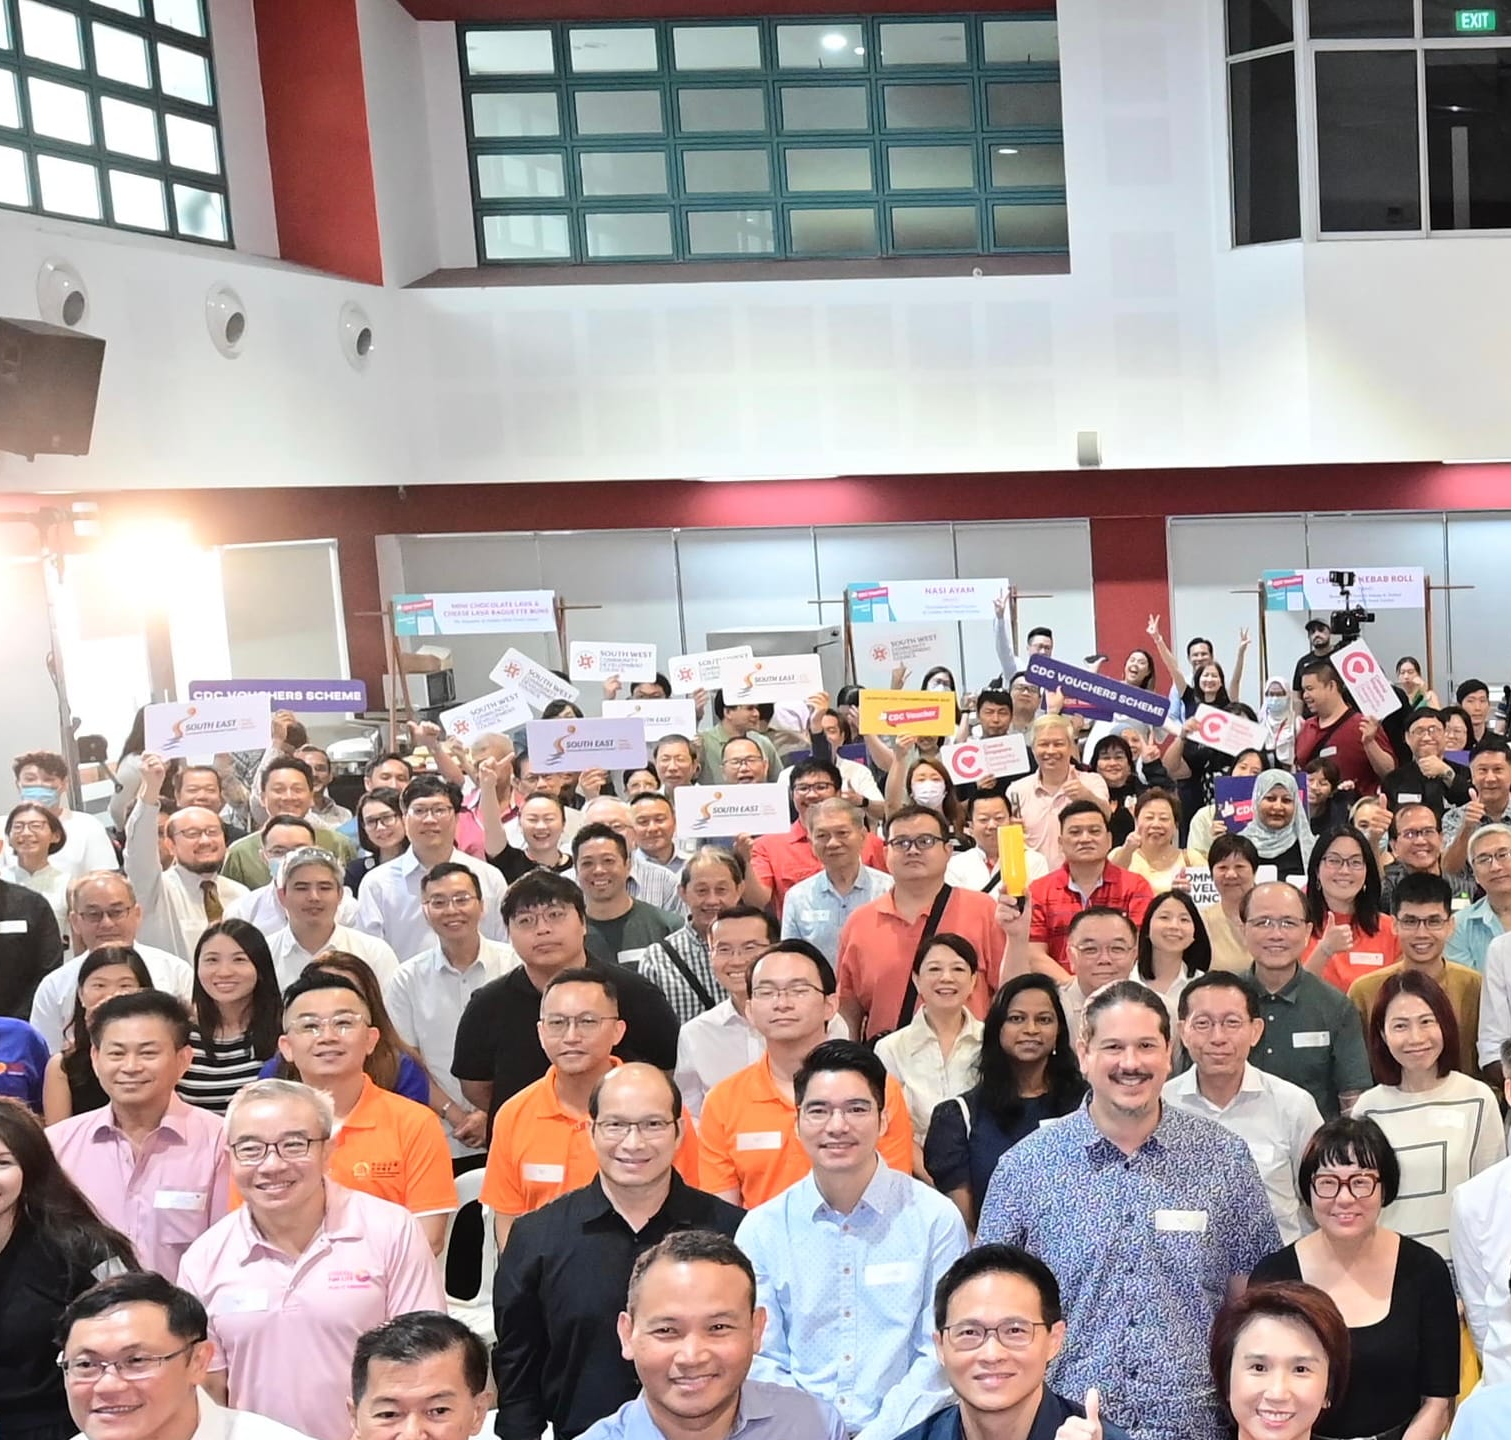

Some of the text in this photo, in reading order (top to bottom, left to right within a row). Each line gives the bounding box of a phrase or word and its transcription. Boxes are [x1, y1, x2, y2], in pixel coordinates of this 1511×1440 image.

[1462, 13, 1489, 28] EXIT
[306, 691, 361, 700] SCHEME
[1030, 663, 1054, 679] CDC
[1057, 672, 1117, 702] VOUCHERS
[1118, 694, 1164, 717] SCHEME
[888, 709, 937, 723] CDC Voucher
